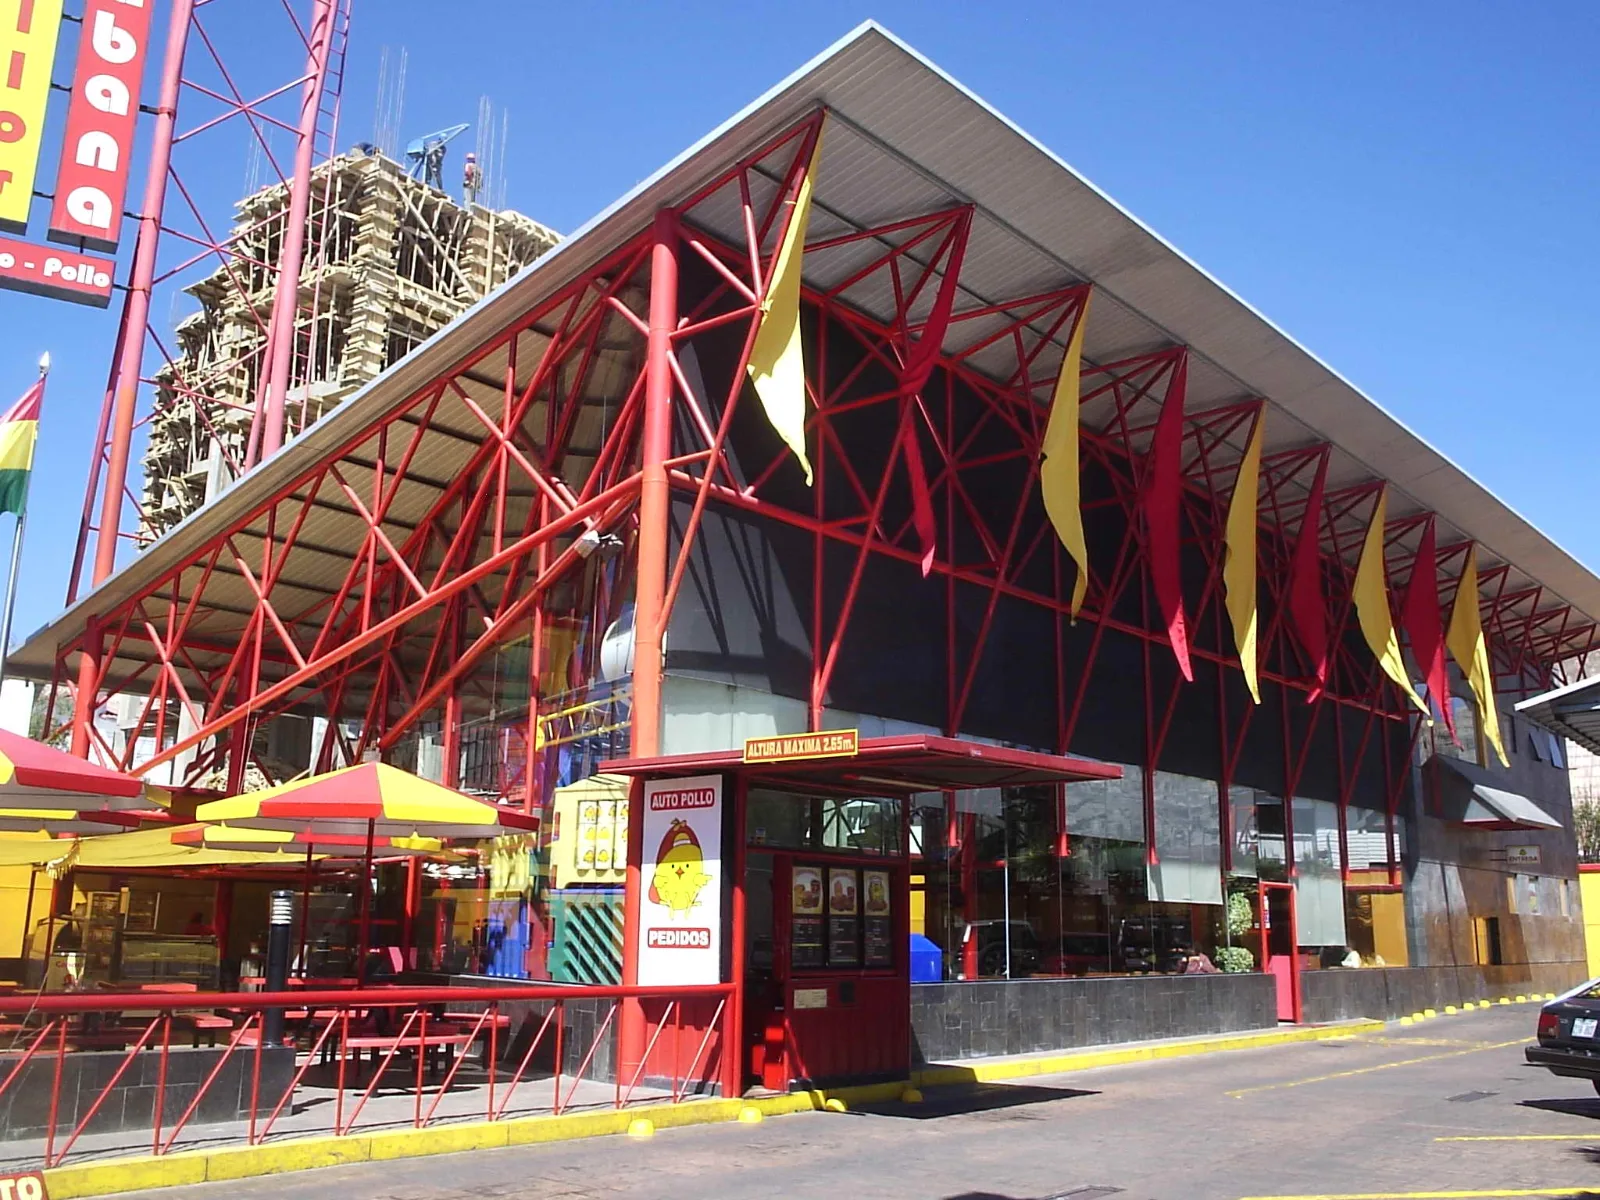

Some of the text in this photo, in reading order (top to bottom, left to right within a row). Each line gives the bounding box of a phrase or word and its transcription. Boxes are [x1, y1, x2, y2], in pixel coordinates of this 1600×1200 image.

[67, 0, 144, 229] bana
[43, 257, 110, 288] Pollo
[747, 742, 782, 758] ALTURA
[784, 738, 823, 756] MAXIMA
[652, 791, 713, 809] AUTO POLLO
[648, 930, 709, 947] PEDIDOS
